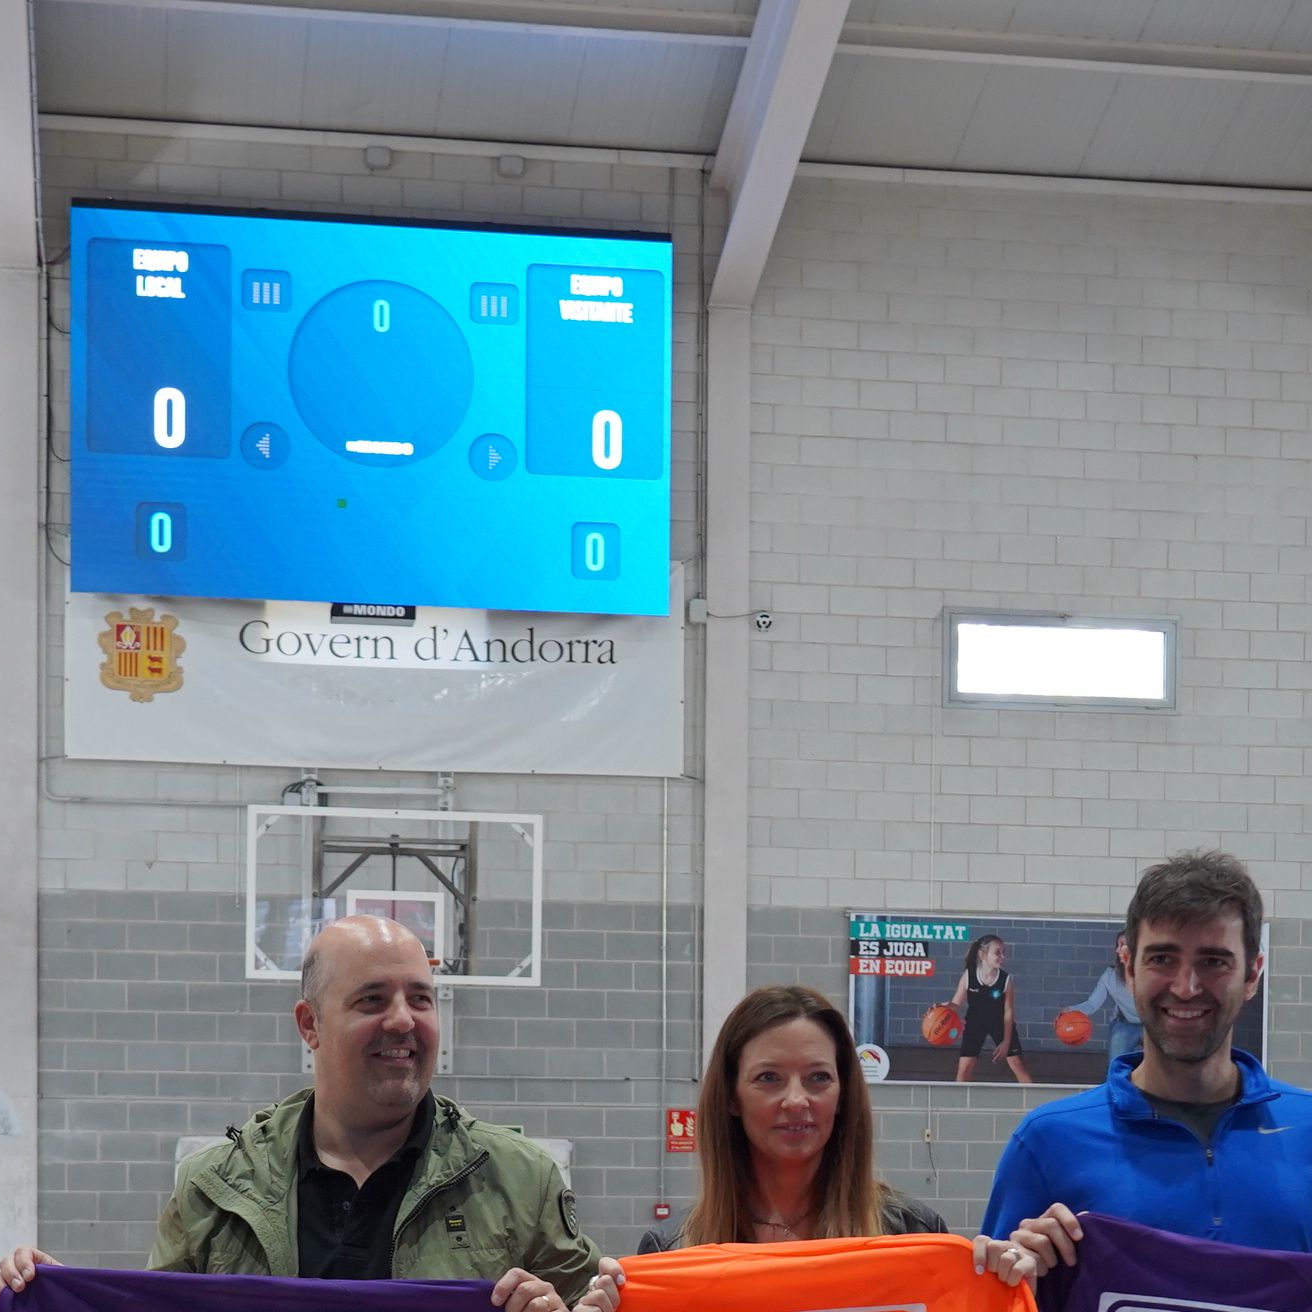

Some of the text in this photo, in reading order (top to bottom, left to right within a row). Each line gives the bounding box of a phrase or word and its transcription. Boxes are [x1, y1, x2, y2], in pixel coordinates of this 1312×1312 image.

[373, 299, 390, 333] 0
[153, 386, 186, 449] 0
[591, 409, 623, 470] 0
[150, 511, 172, 553] 0
[584, 532, 606, 572] 0
[353, 604, 406, 617] MONDO
[238, 619, 617, 666] Govern d'Andorra
[858, 923, 966, 940] LA IGUALTAT
[858, 941, 926, 958] ES JUGA
[858, 959, 932, 976] EN EQUIP
